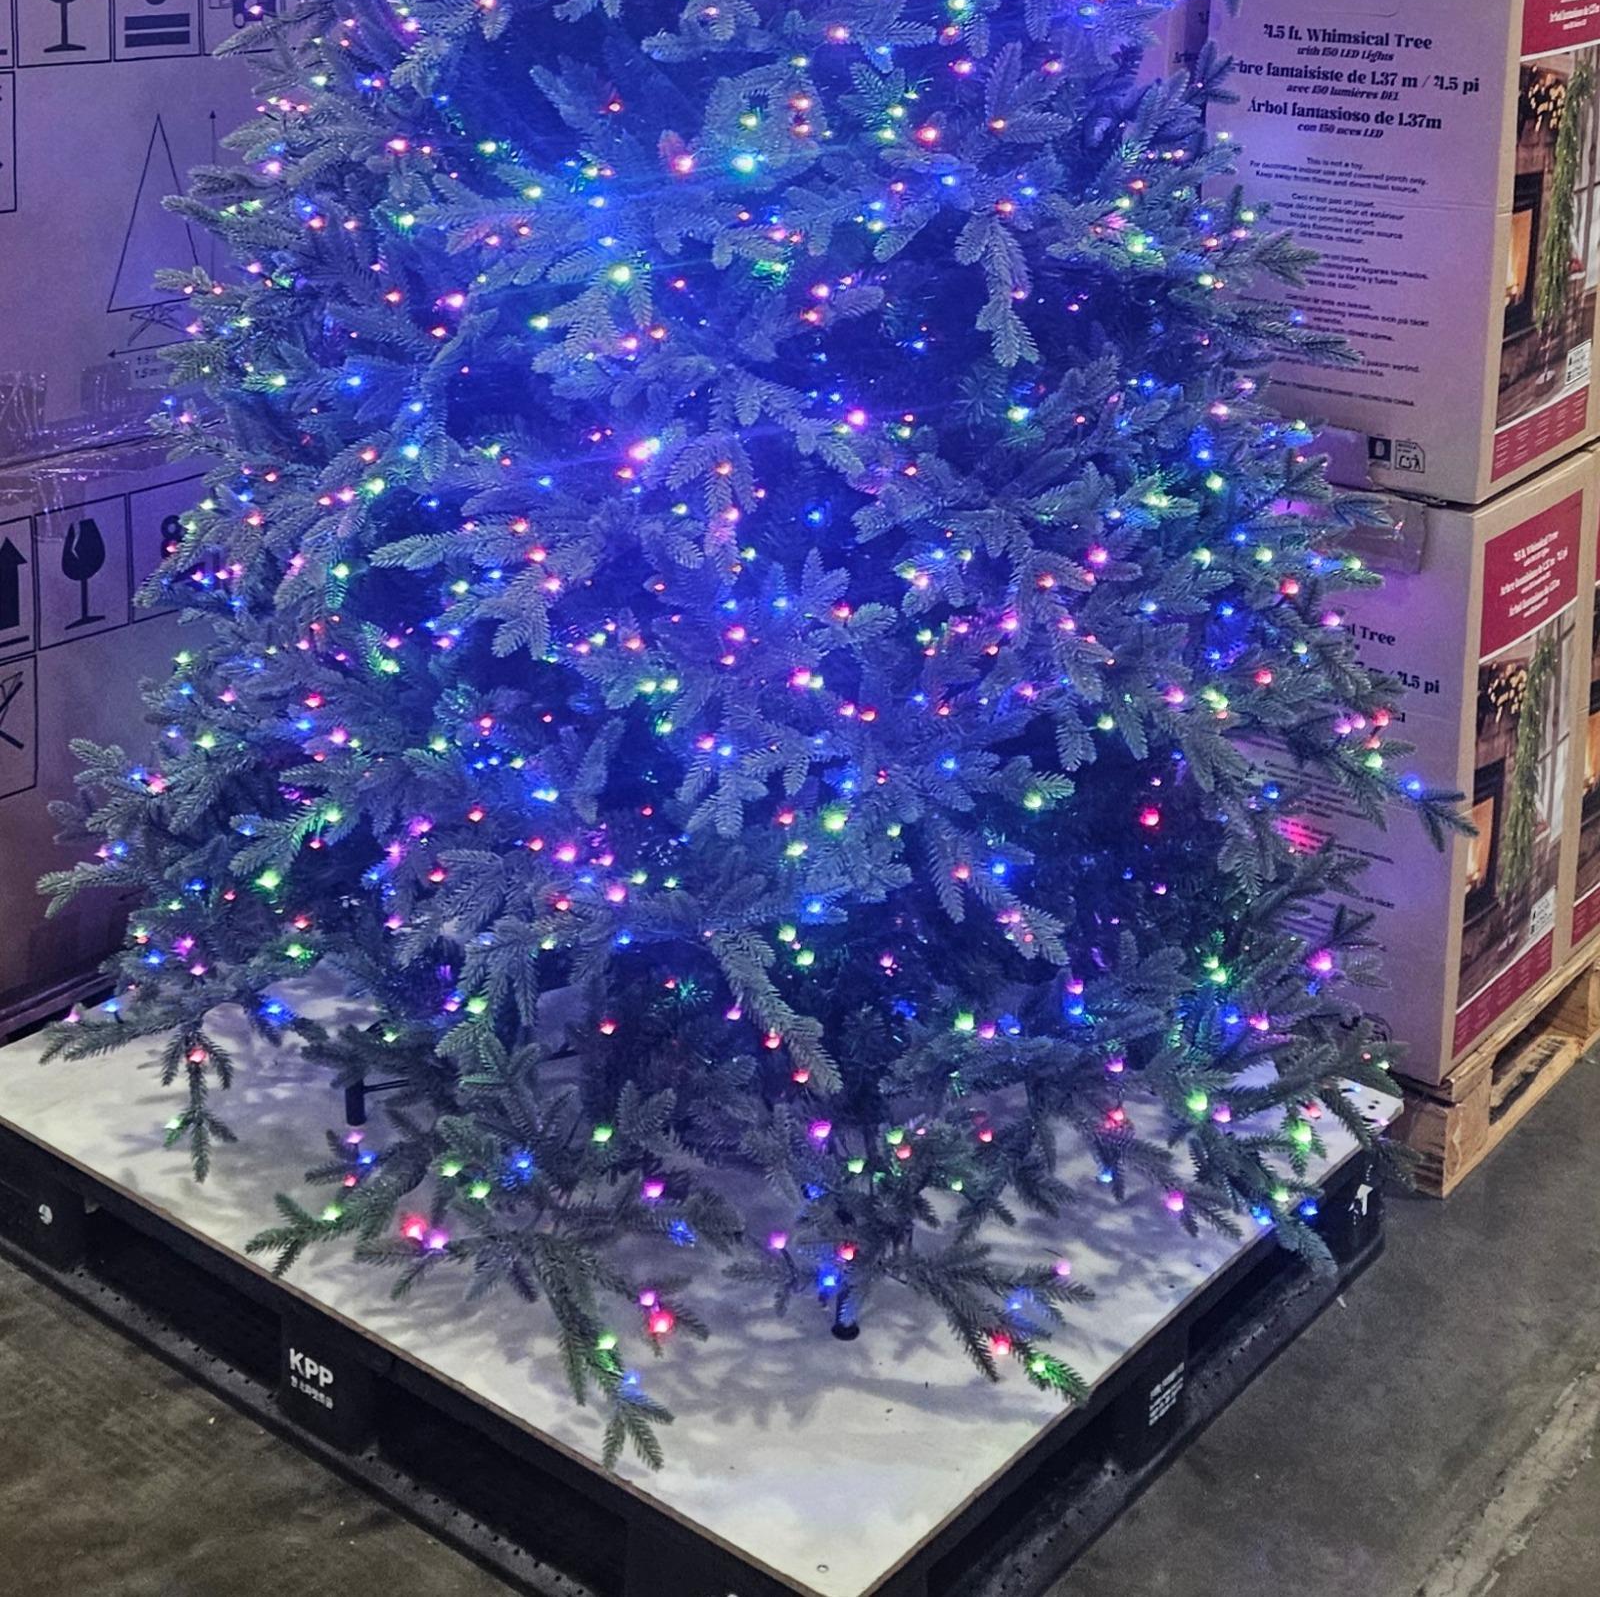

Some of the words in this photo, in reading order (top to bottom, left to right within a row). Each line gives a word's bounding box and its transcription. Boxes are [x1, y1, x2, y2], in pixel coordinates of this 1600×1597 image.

[1263, 23, 1285, 39] 4.5
[1288, 25, 1302, 42] ft.
[1307, 27, 1390, 47] Whimsical
[1394, 33, 1432, 50] Tree
[1297, 45, 1320, 56] with
[1321, 47, 1339, 57] 150
[1340, 48, 1360, 59] LED
[1361, 50, 1395, 63] Lights
[1266, 62, 1344, 83] fantaisiste
[1347, 69, 1367, 85] de
[1371, 71, 1398, 87] 1.37
[1402, 77, 1418, 88] m
[1433, 74, 1458, 92] 4.5
[1462, 77, 1480, 96] pi
[1286, 84, 1311, 94] avec
[1312, 85, 1329, 95] 150
[1330, 86, 1379, 100] lumières
[1248, 99, 1288, 116] Árbol
[1291, 102, 1371, 124] fantasioso
[1374, 110, 1395, 126] de
[1398, 112, 1442, 130] 1.37m
[1297, 123, 1317, 132] con
[1318, 123, 1336, 133] 150
[1362, 127, 1384, 138] LED
[1307, 157, 1321, 165] This
[1256, 170, 1273, 179] Keep
[1274, 173, 1292, 182] away
[1293, 174, 1311, 183] from
[1333, 179, 1347, 187] and
[1349, 180, 1371, 189] direct
[1323, 169, 1336, 177] use
[1338, 171, 1352, 179] and
[1353, 172, 1384, 181] covered
[1385, 174, 1408, 183] porch
[1360, 625, 1396, 646] Tree
[1424, 679, 1440, 695] pi
[290, 1348, 334, 1388] KPP
